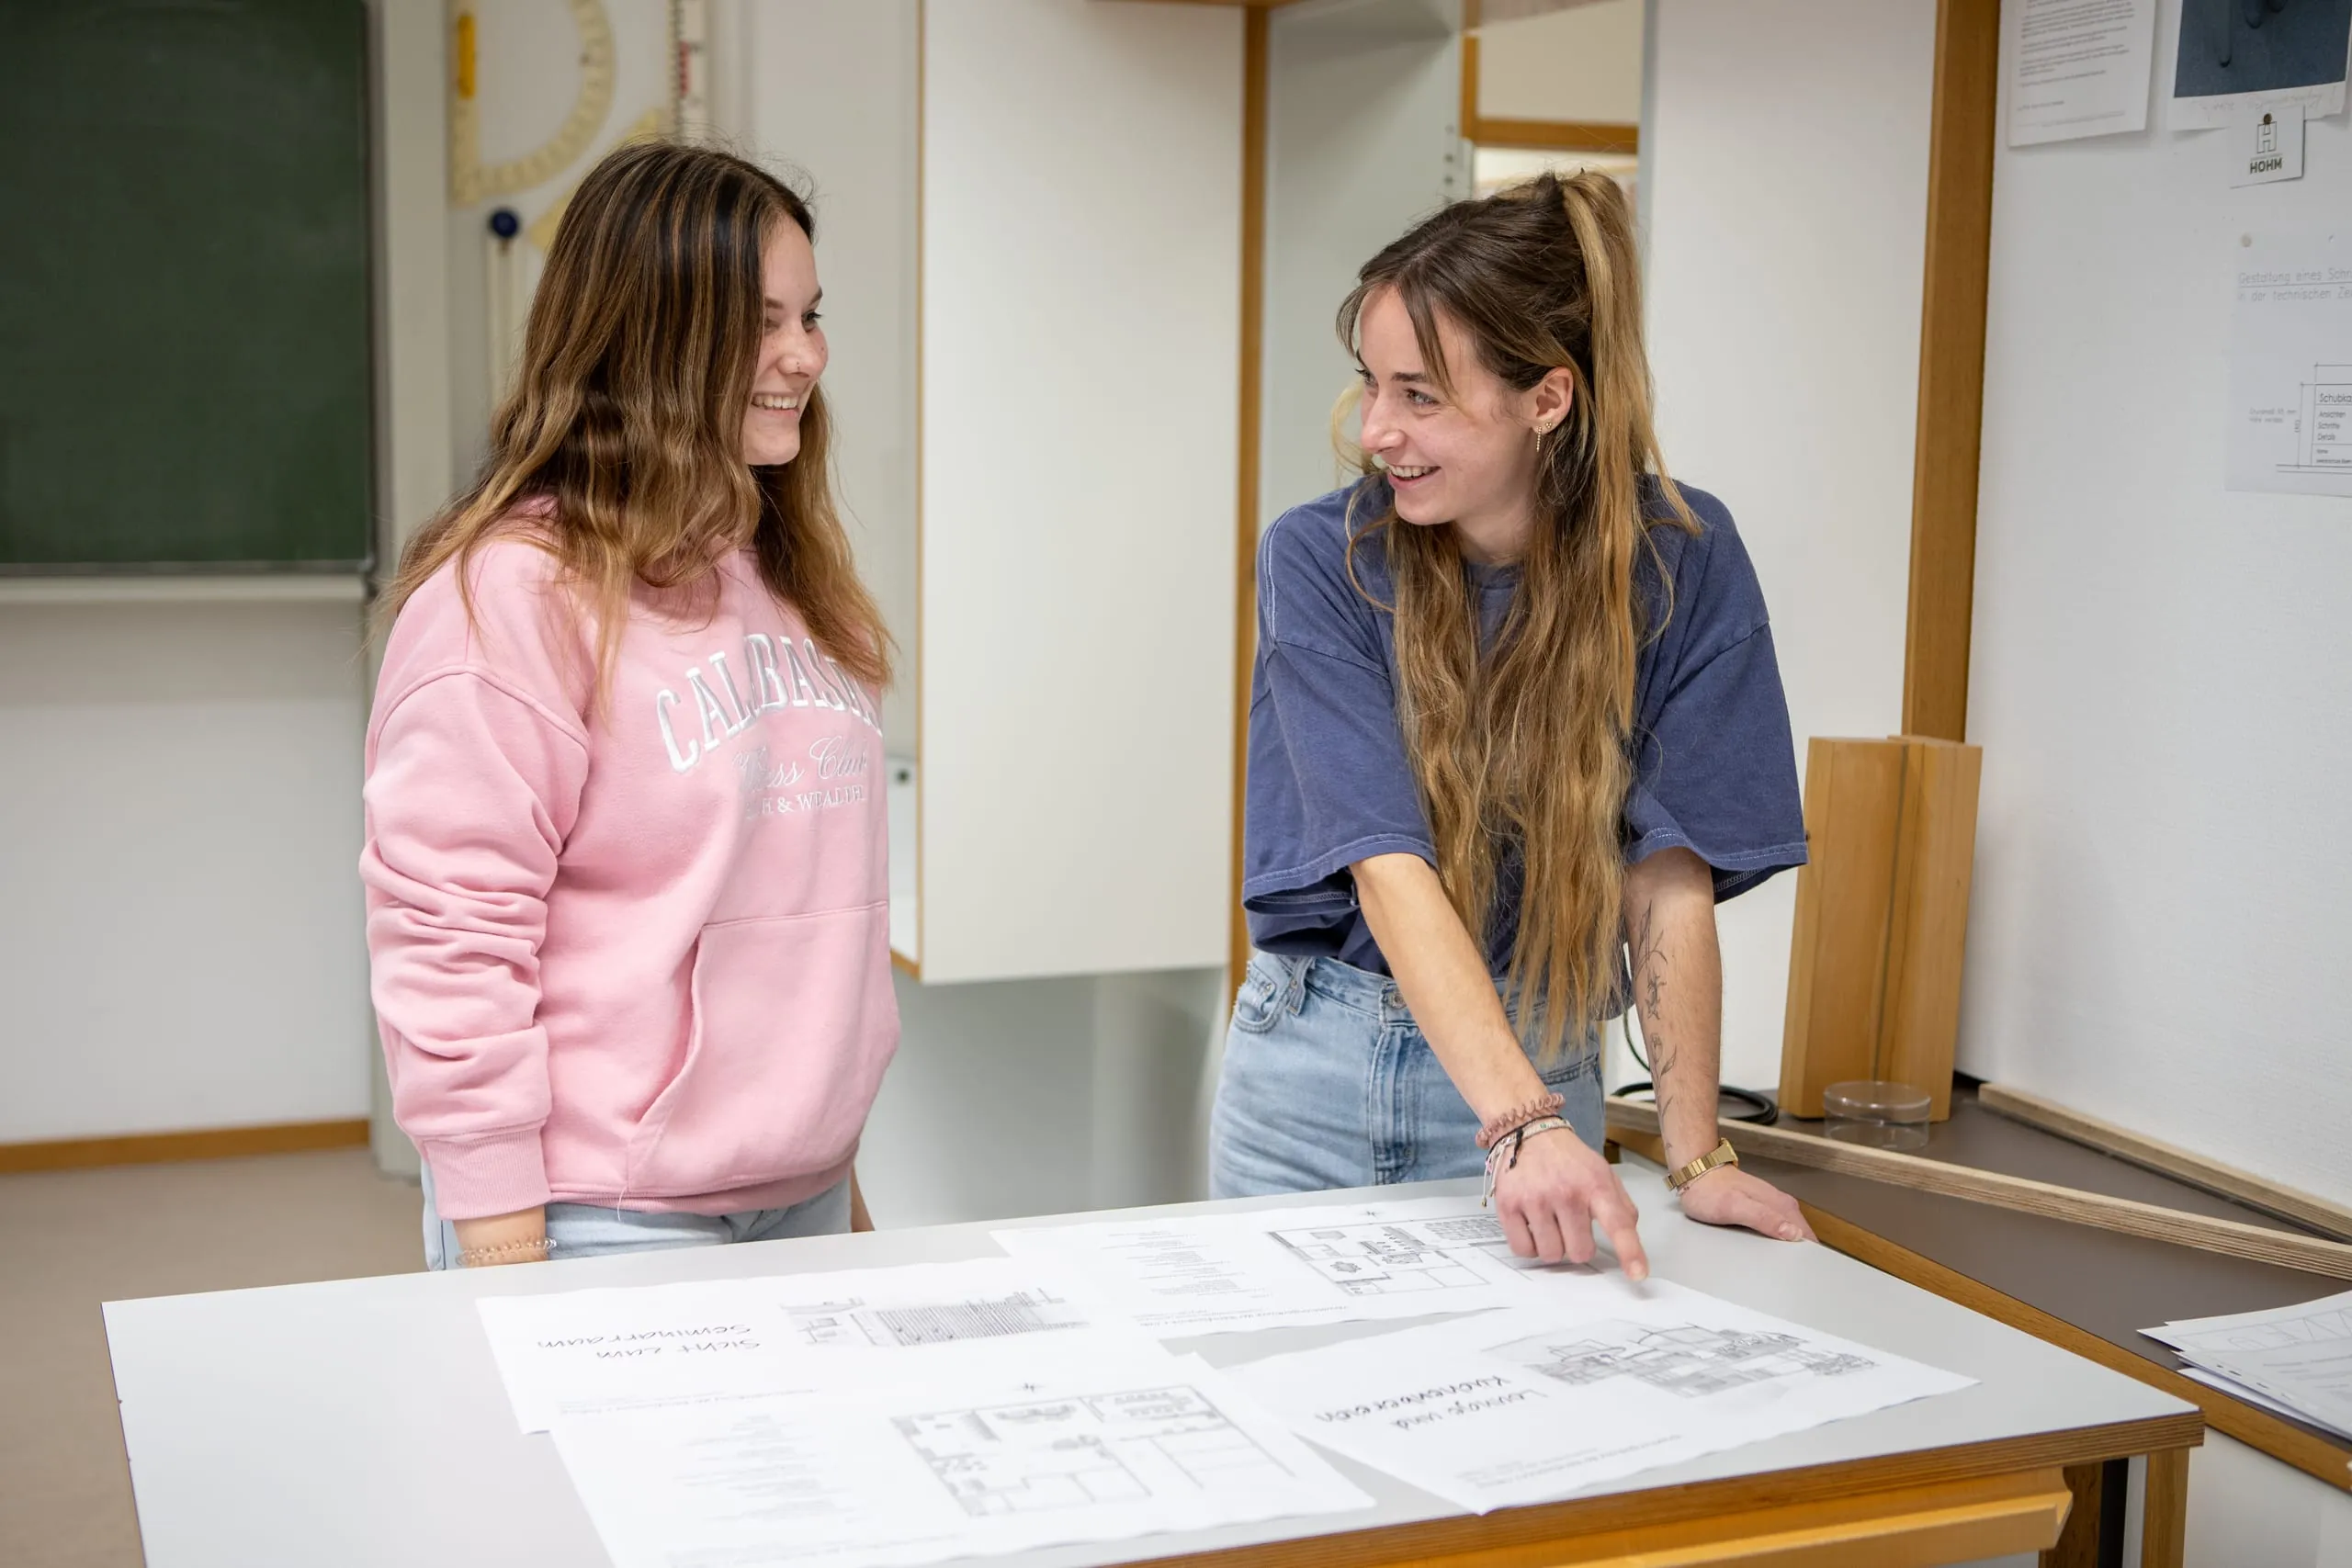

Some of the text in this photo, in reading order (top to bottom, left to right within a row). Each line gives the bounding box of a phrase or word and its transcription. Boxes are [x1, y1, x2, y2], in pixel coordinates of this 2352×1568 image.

[2249, 157, 2283, 175] HOHM
[2252, 290, 2267, 301] der
[2273, 287, 2332, 301] technischen
[776, 795, 796, 814] &
